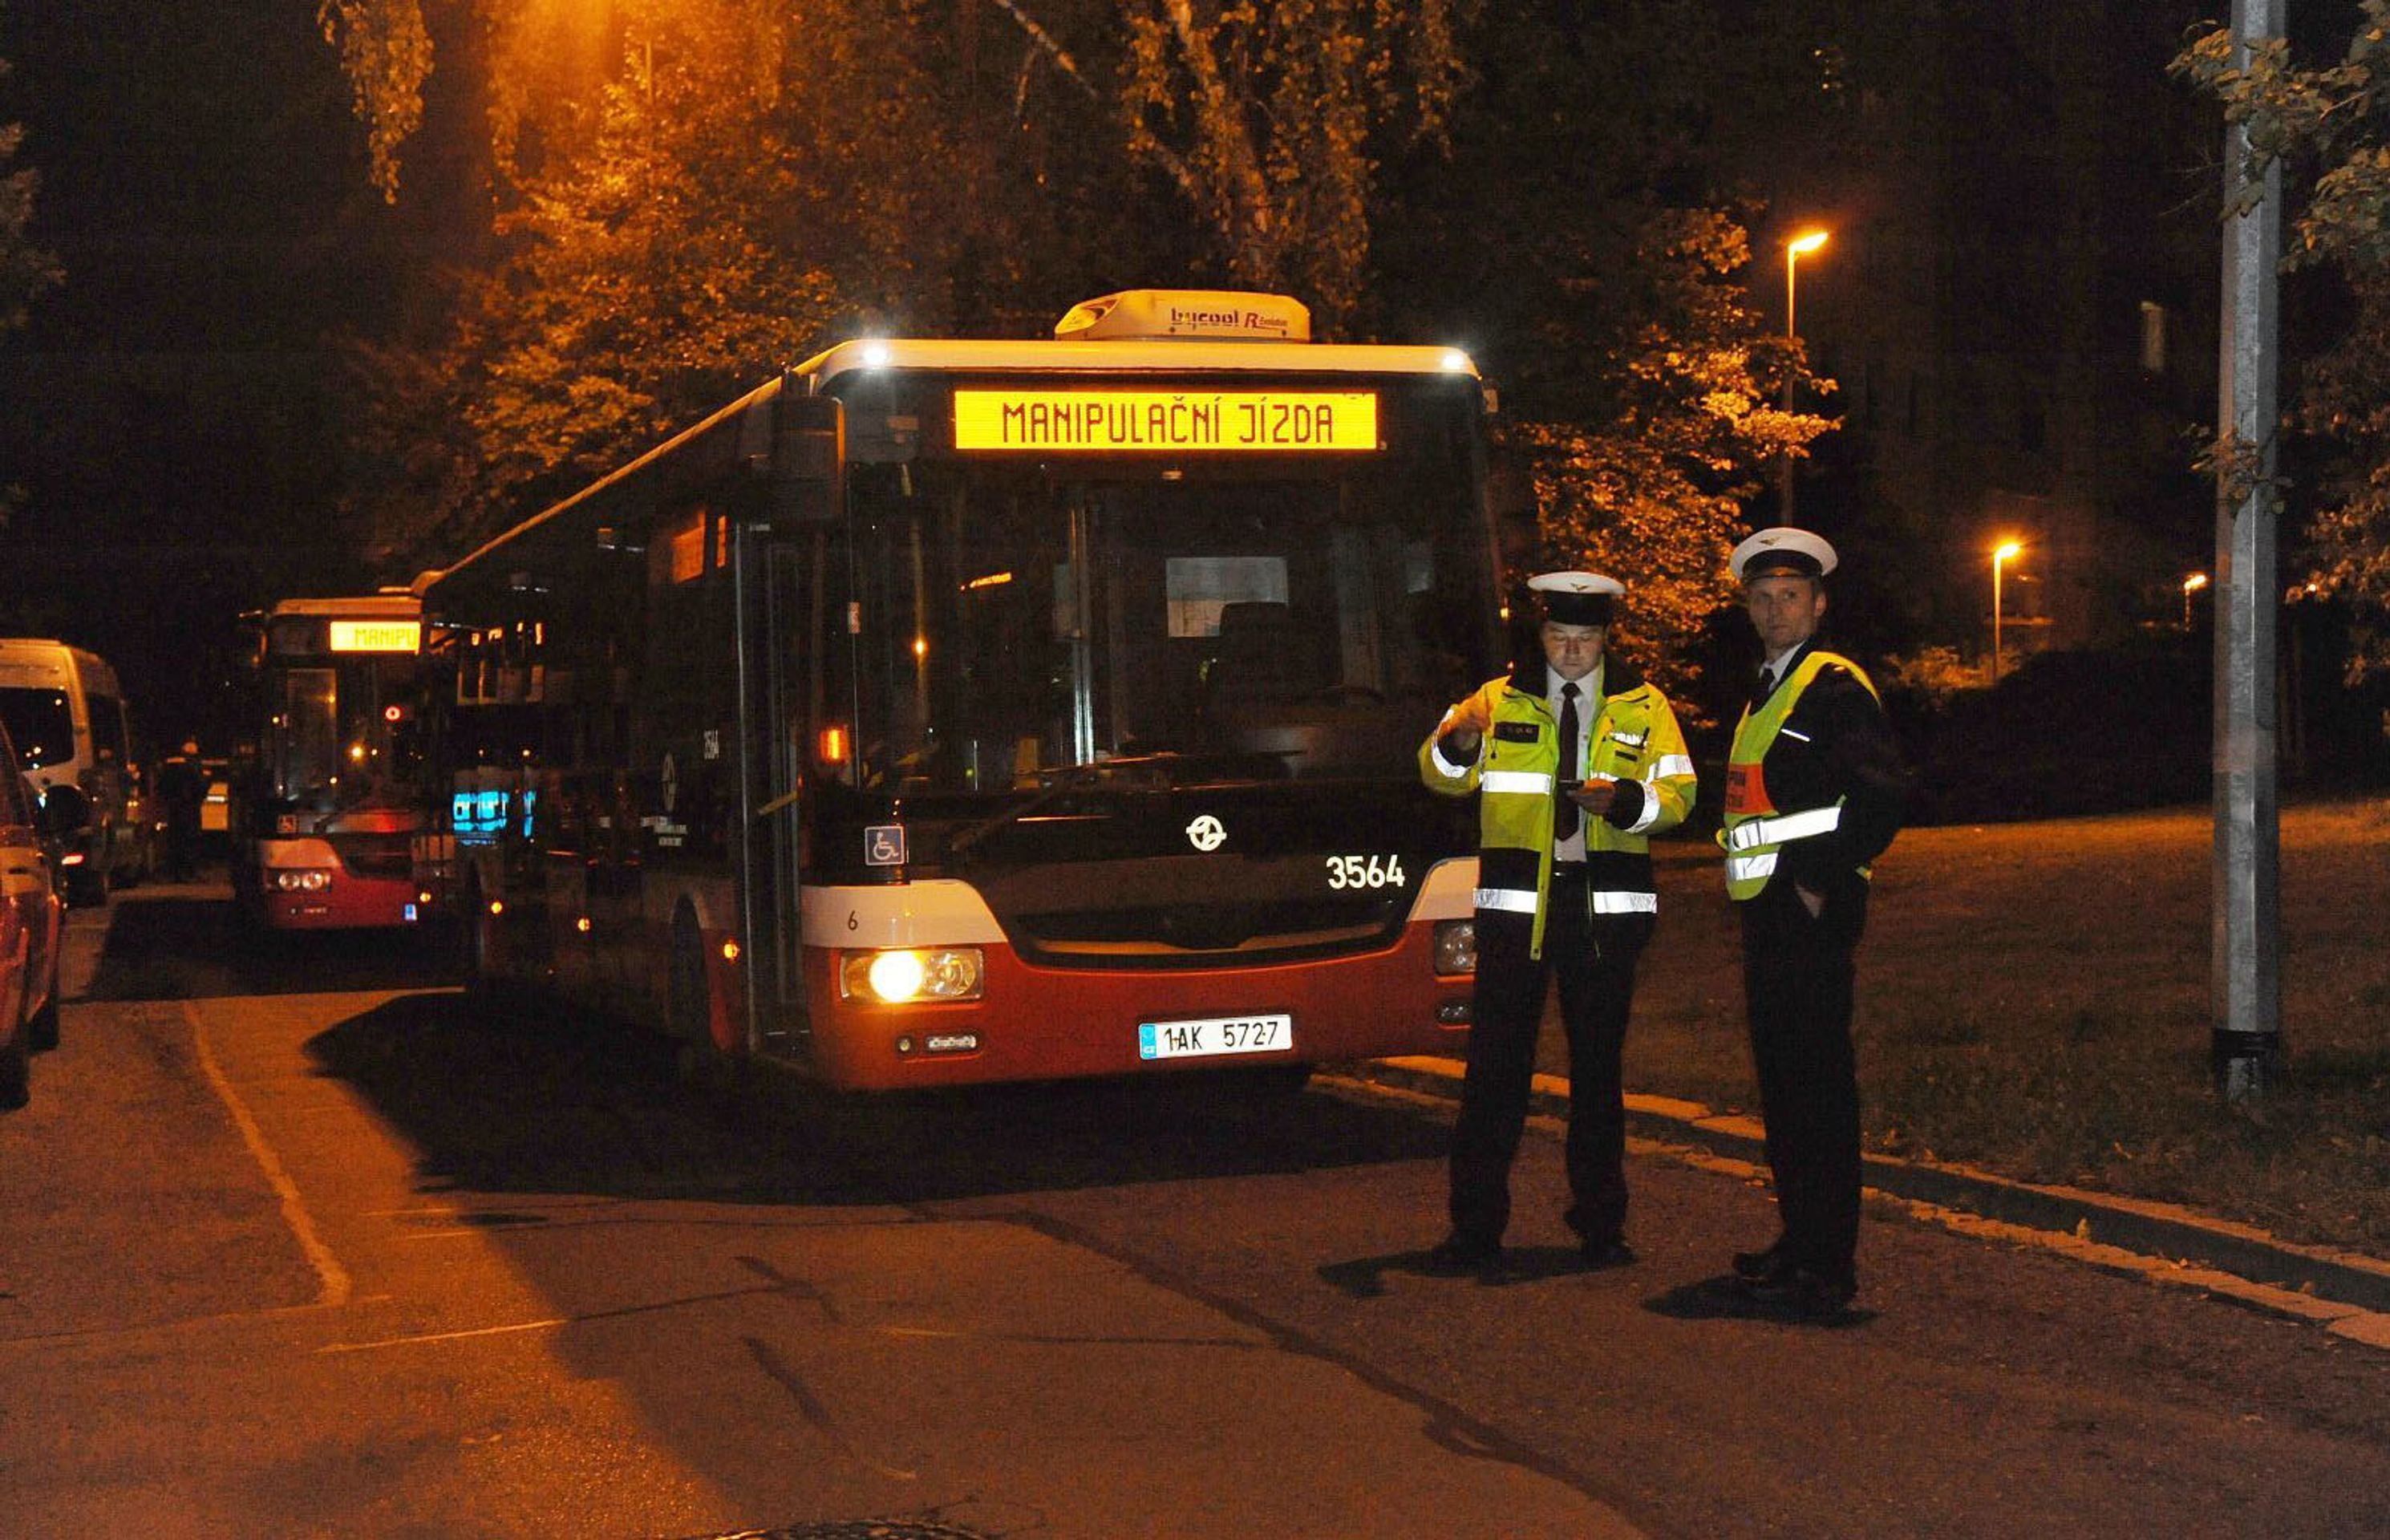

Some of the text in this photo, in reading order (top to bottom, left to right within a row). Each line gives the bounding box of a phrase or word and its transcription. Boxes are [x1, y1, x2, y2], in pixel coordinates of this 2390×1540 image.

[1002, 395, 1333, 444] MANIPULAČNÍ JÍZDA
[1326, 854, 1405, 890] 3564
[848, 910, 858, 930] 6
[1164, 1021, 1278, 1052] 1AK 5727
